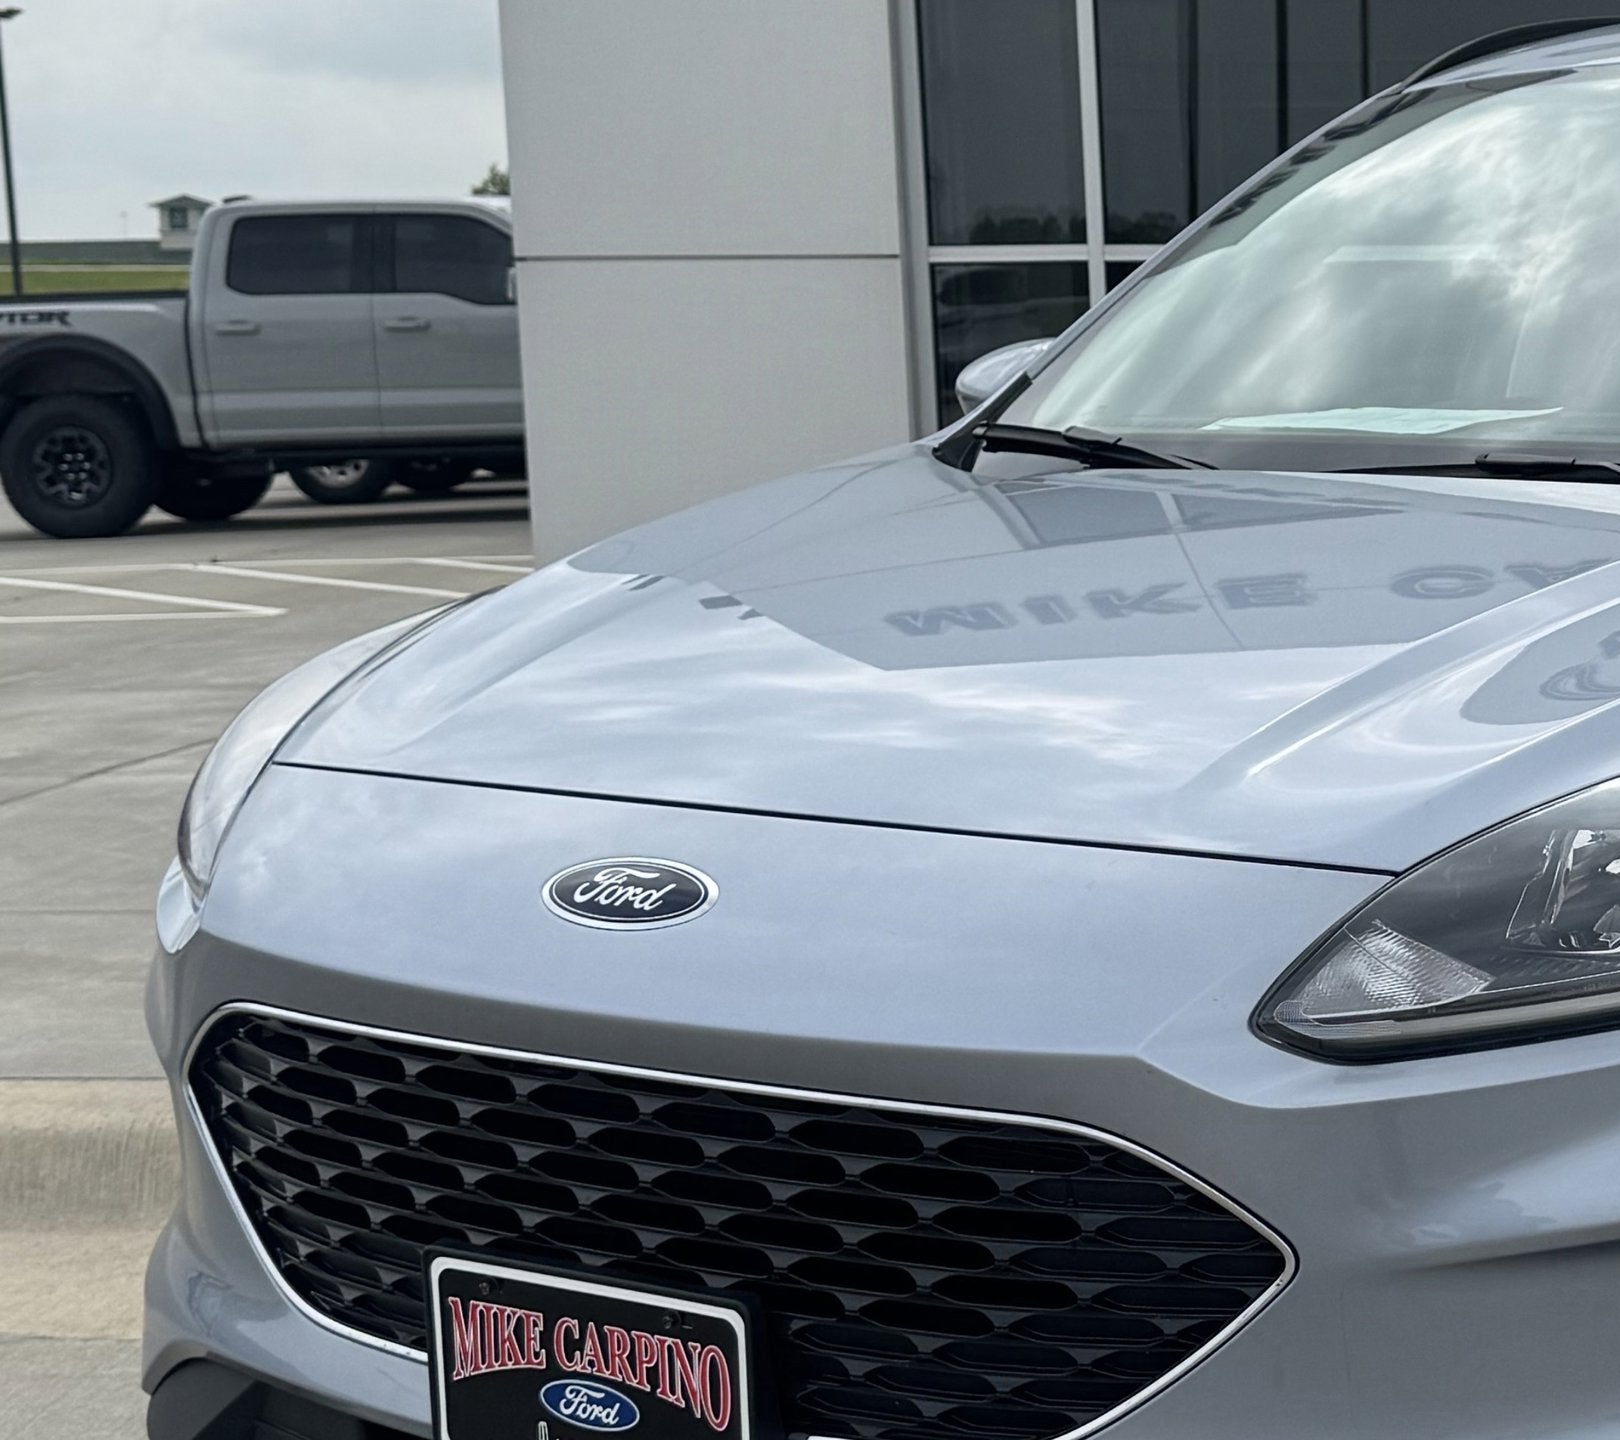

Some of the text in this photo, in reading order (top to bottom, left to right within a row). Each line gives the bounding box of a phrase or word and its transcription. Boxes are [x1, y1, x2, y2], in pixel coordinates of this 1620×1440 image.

[0, 310, 73, 327] TOR
[574, 867, 676, 911] Ford
[448, 1297, 731, 1432] MIKE CARPINO
[560, 1384, 620, 1425] Ford
